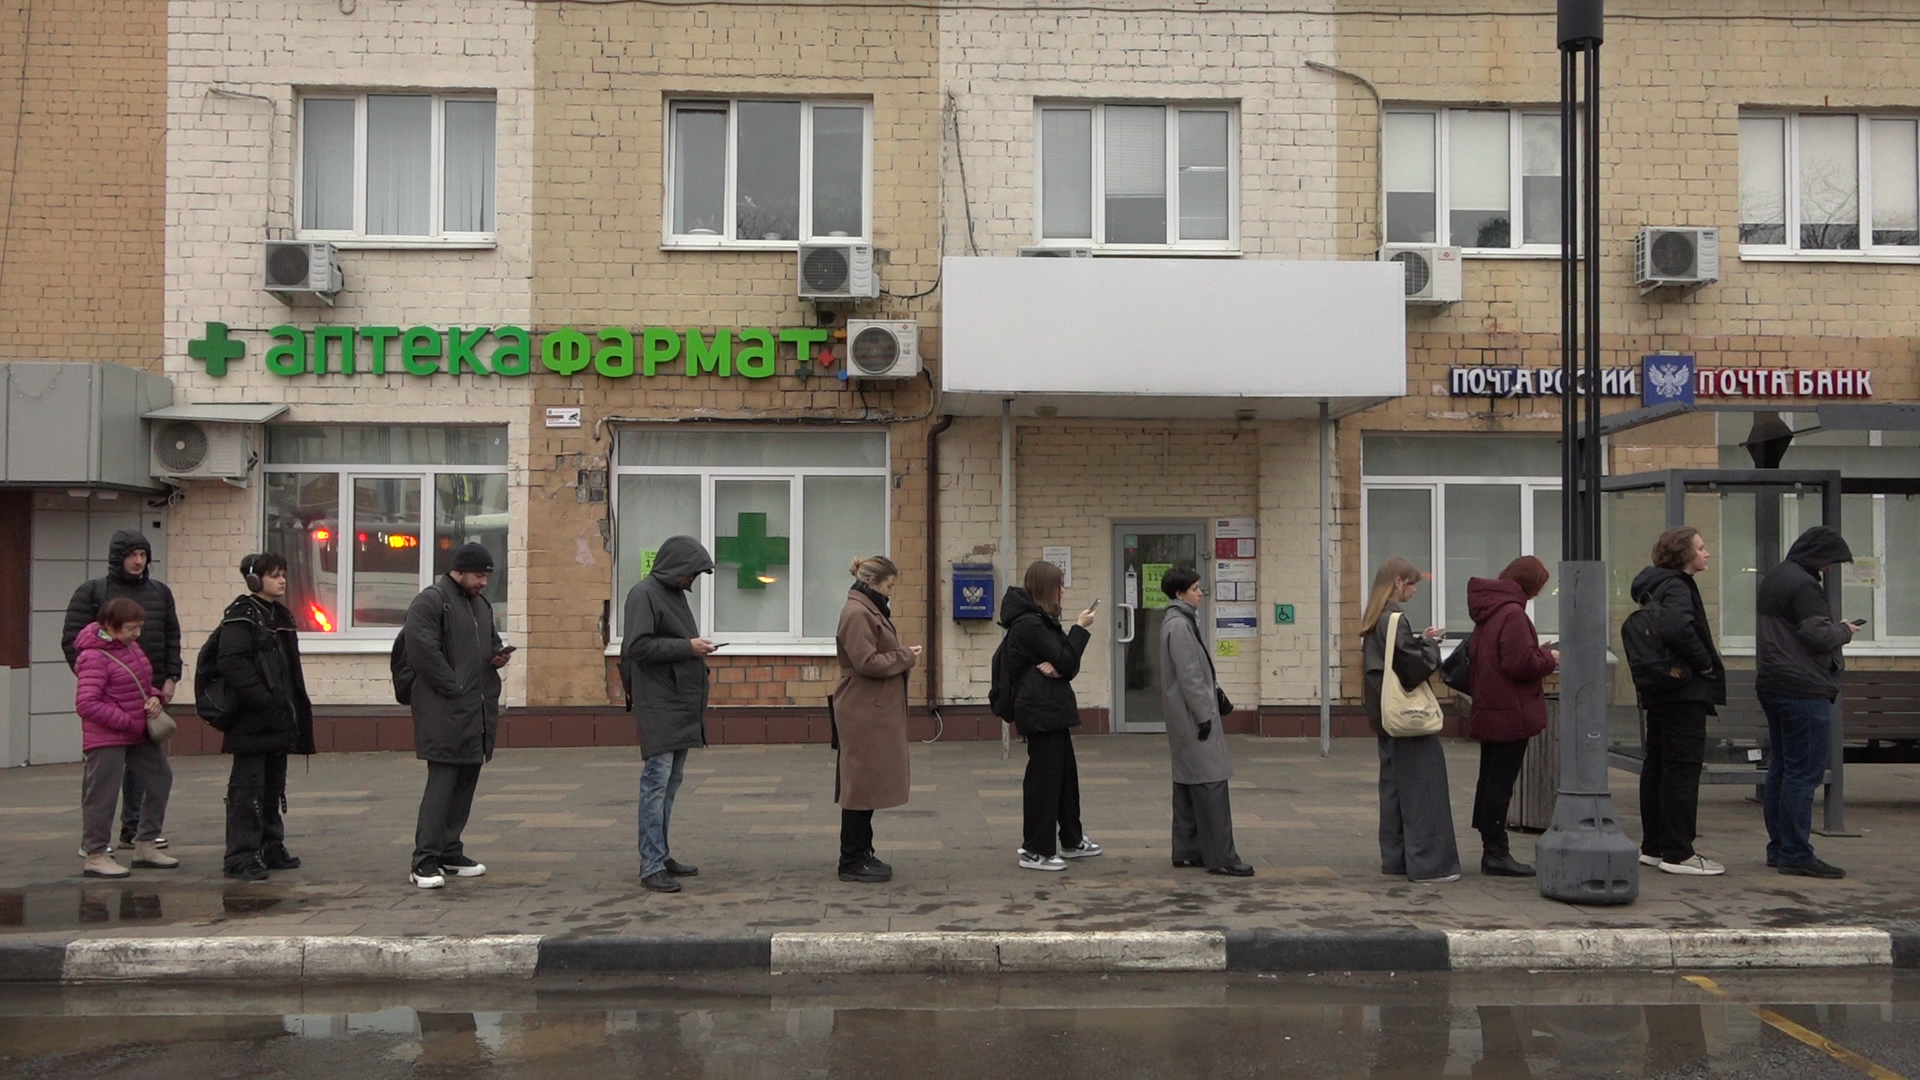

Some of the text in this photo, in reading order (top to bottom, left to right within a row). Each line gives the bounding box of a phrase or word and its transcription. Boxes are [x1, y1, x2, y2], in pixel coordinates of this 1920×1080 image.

[265, 325, 531, 376] аптека
[1452, 368, 1533, 395] ПОЧТА
[1699, 369, 1873, 396] ПОЧТА БАНК
